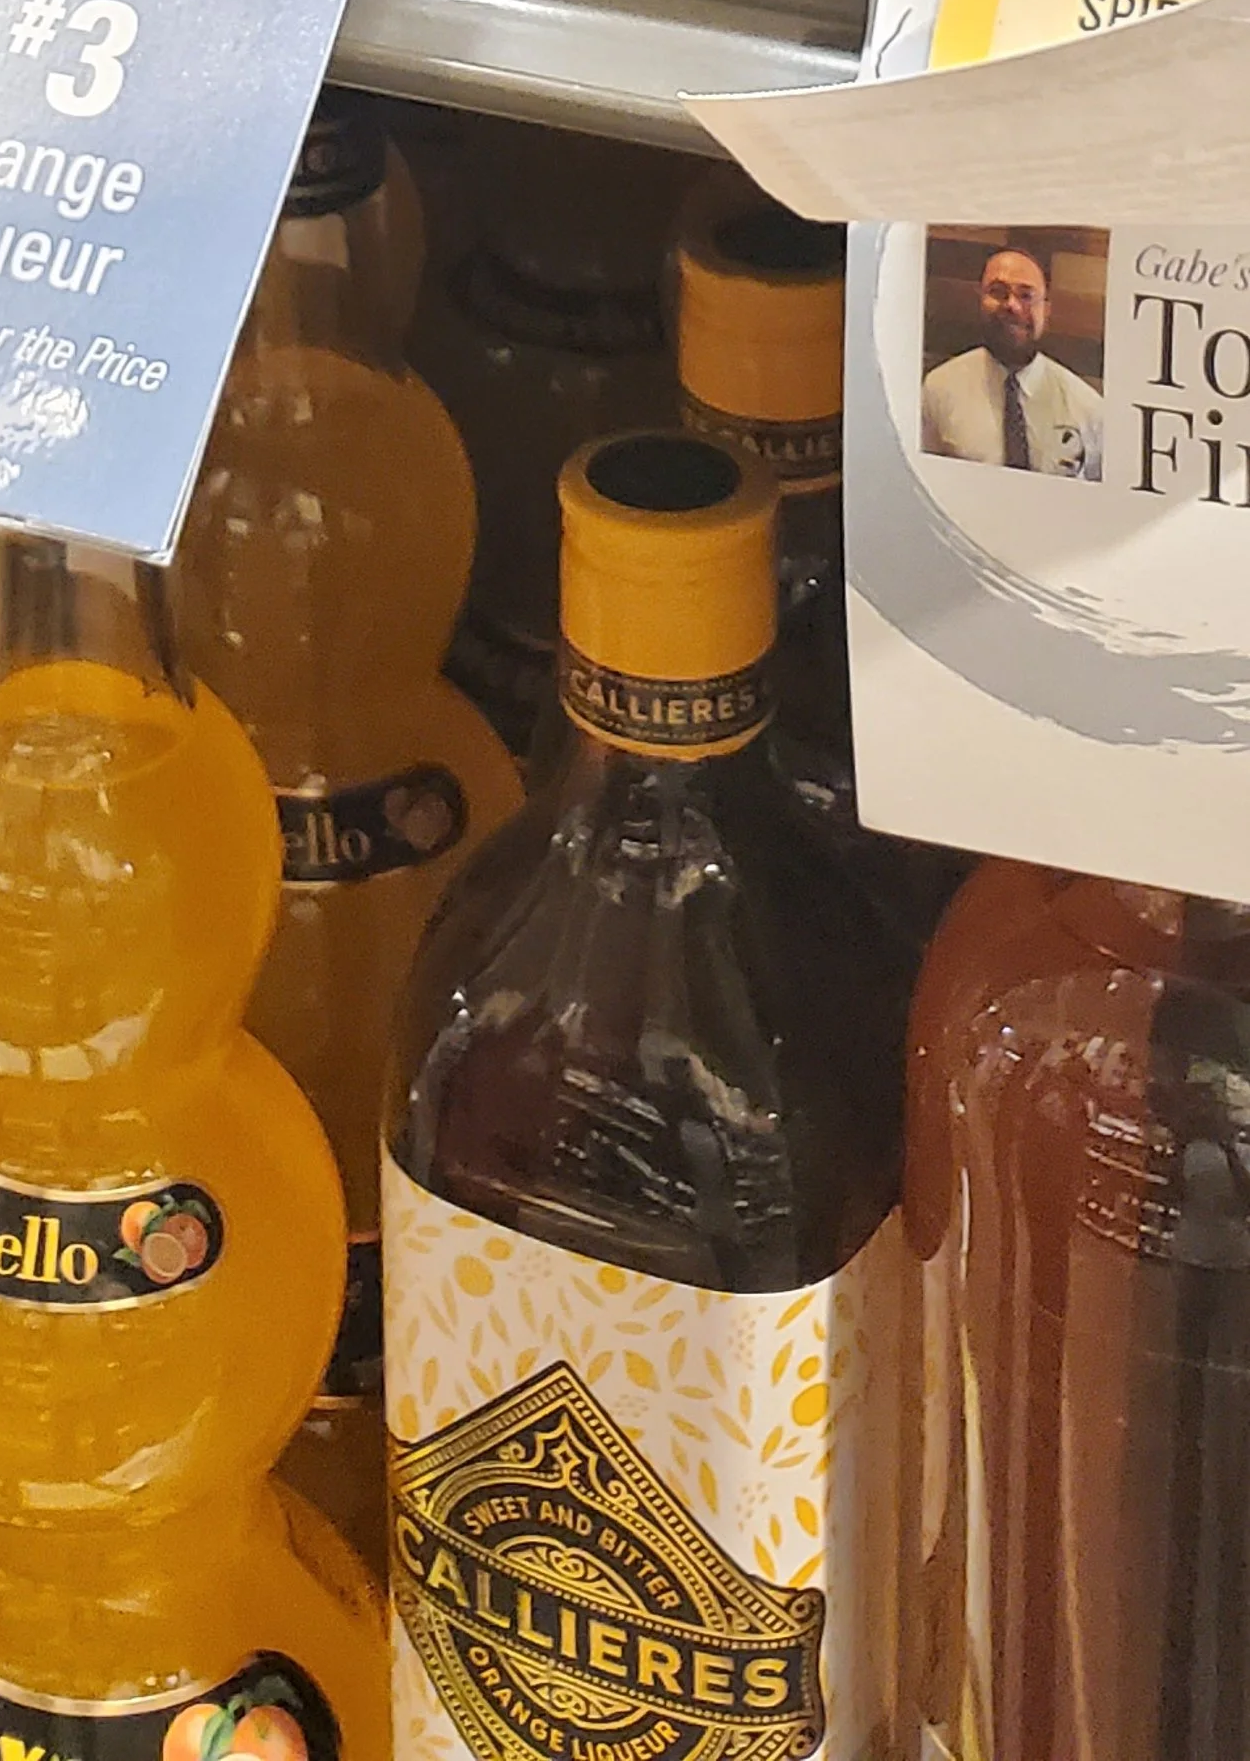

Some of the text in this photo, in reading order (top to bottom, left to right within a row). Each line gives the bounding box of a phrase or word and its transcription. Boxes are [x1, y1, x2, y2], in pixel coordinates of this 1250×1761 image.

[18, 325, 76, 374] the
[75, 337, 169, 394] Price
[570, 668, 756, 727] CALLIERES
[464, 1495, 684, 1611] SWEET AND BITTER
[395, 1515, 791, 1709] CALLIERES
[467, 1645, 565, 1753] ORANGE
